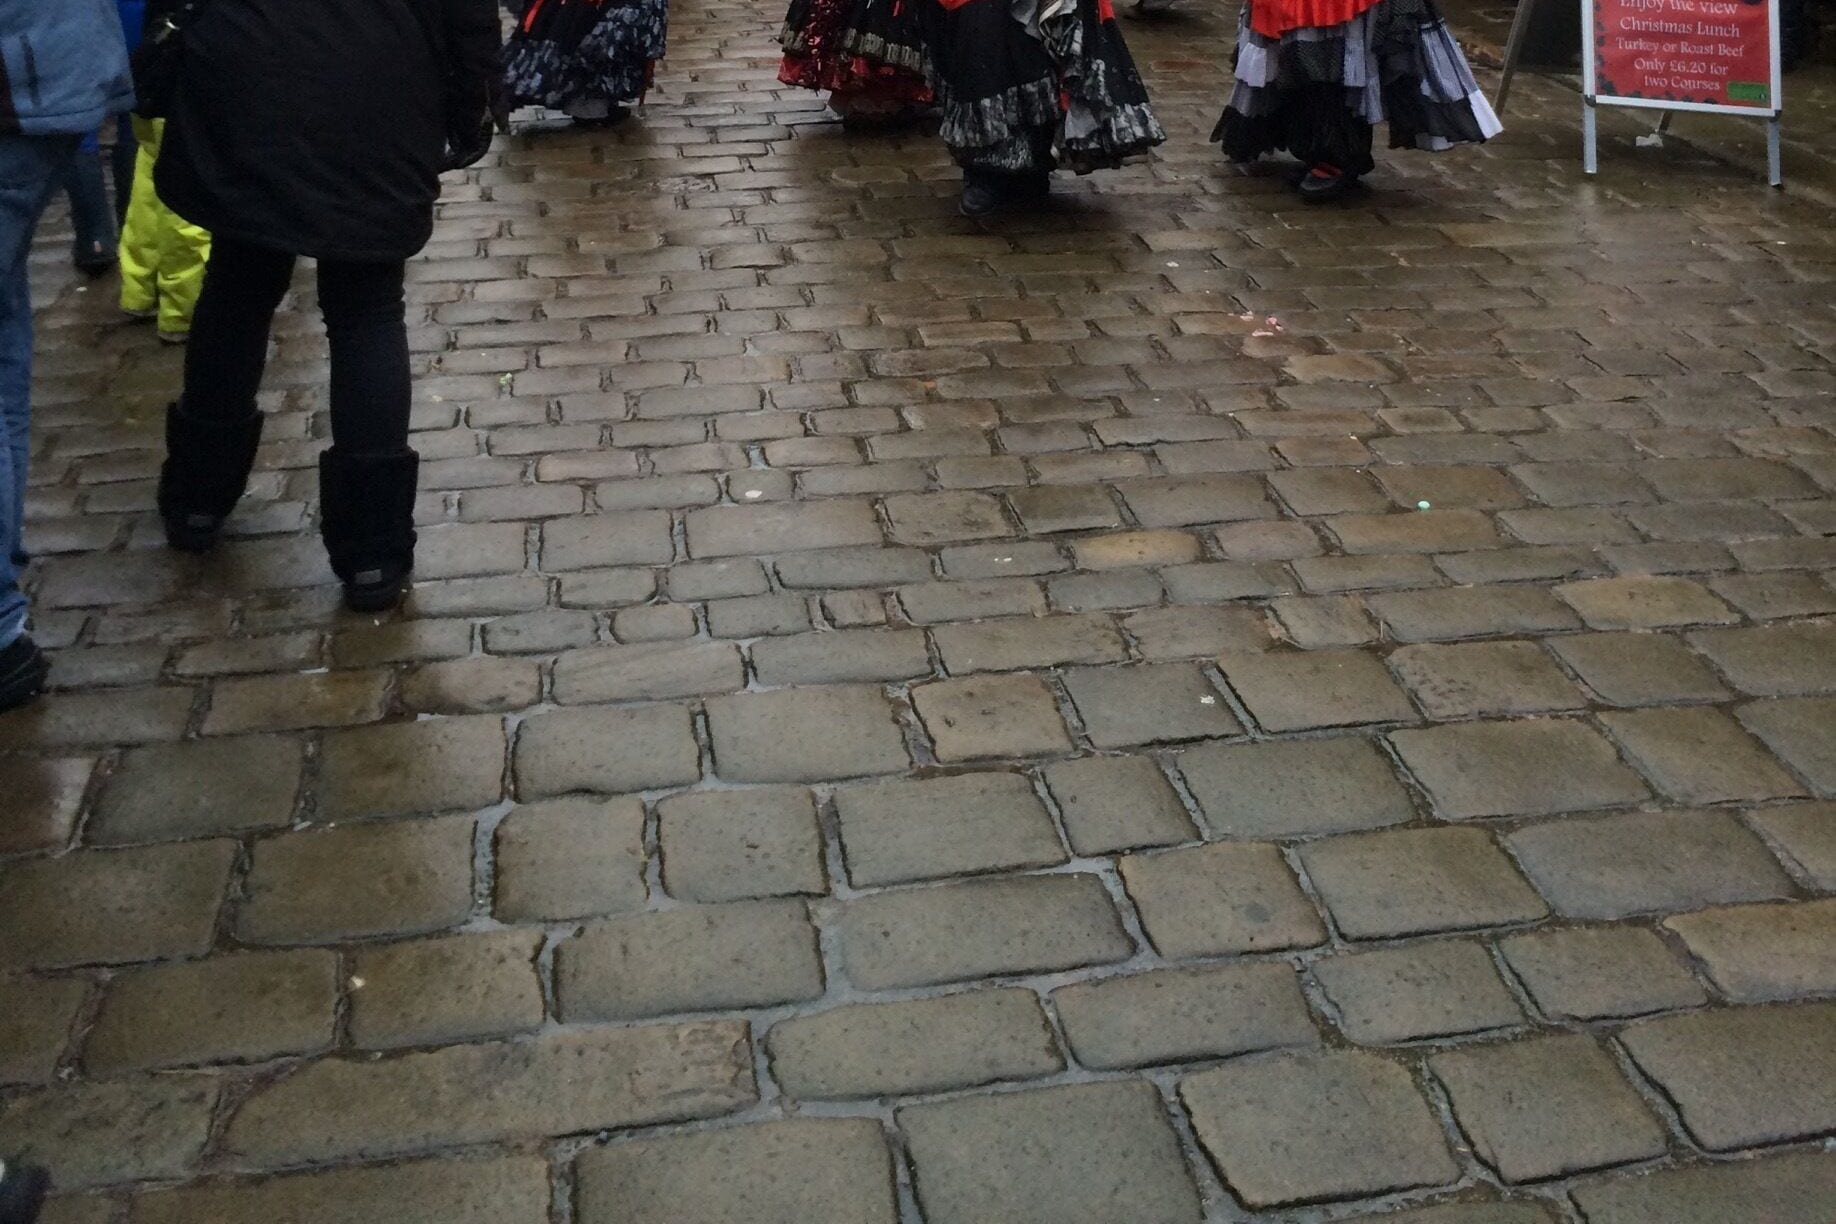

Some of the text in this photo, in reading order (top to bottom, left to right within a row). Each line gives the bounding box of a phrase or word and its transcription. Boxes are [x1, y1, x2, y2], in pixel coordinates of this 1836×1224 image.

[1619, 16, 1740, 38] Christmas Lunch
[1615, 37, 1745, 58] Turkey or Roast Beef
[1634, 57, 1666, 74] Only
[1710, 63, 1729, 76] for
[1671, 76, 1721, 91] Courses
